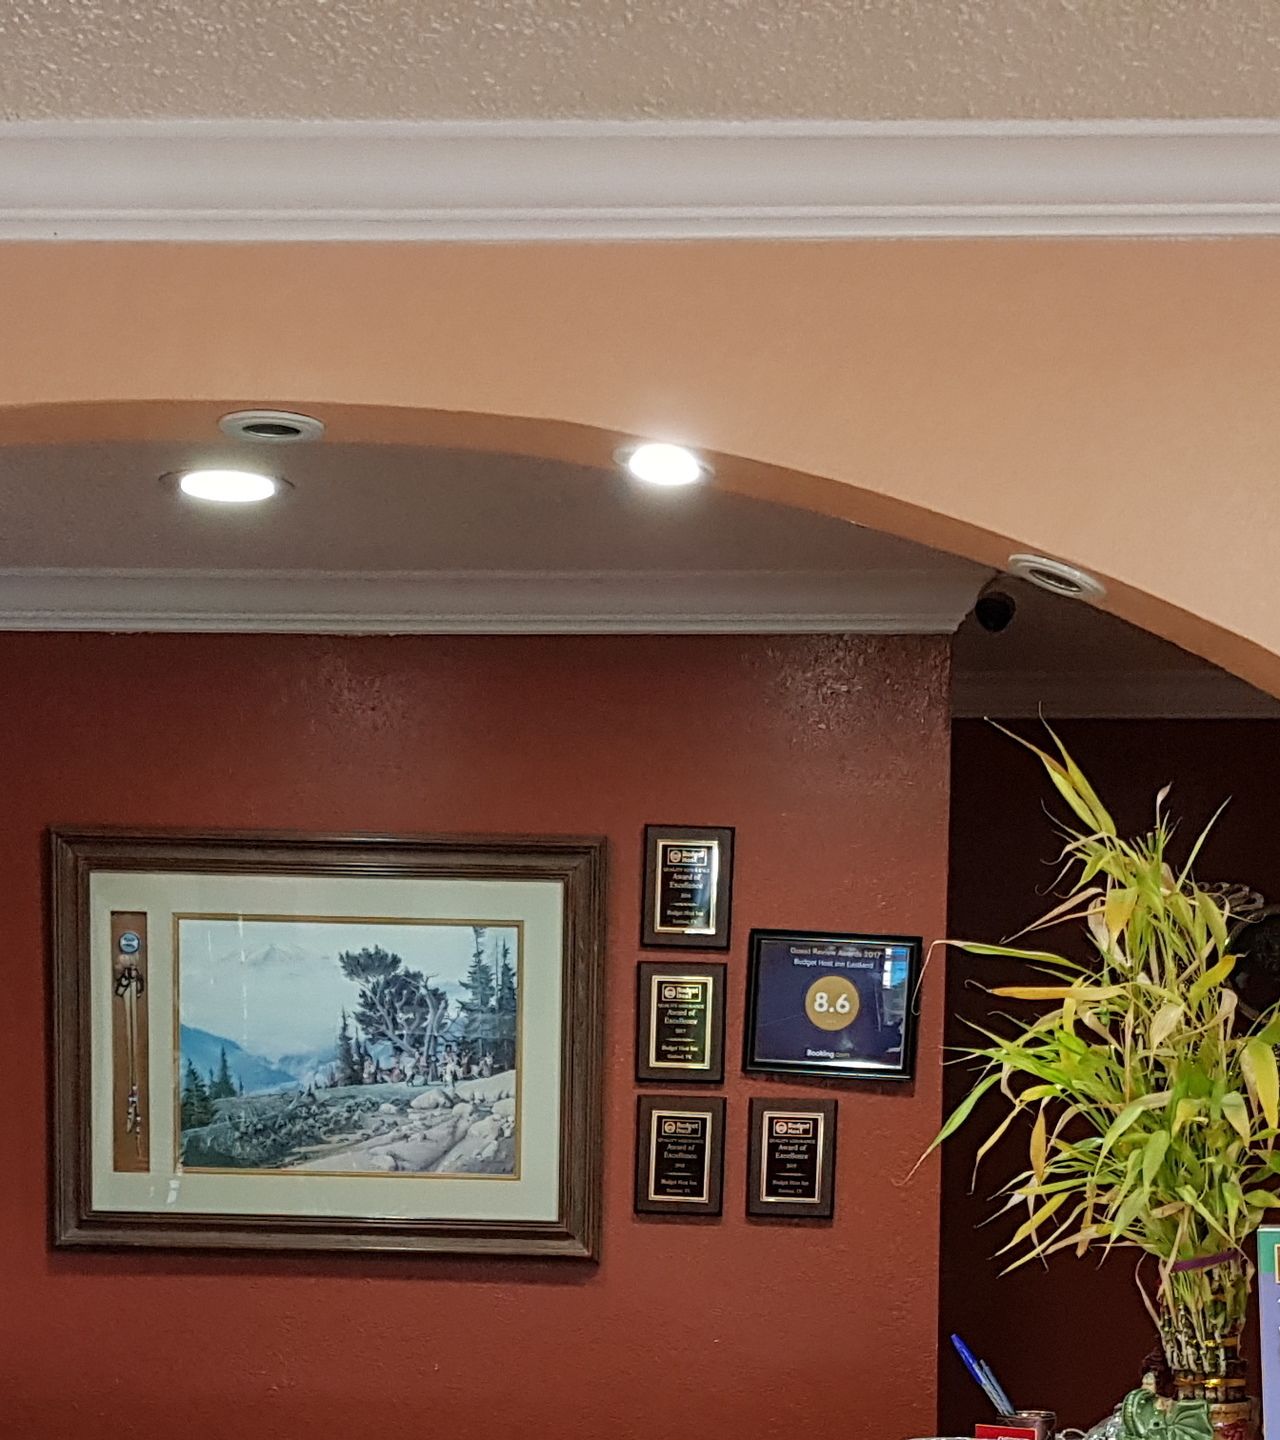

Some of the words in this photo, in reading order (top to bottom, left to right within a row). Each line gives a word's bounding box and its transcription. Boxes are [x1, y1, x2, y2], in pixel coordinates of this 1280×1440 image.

[837, 950, 863, 958] Awards
[793, 958, 817, 968] Budget
[814, 992, 851, 1014] 8.6
[666, 1143, 687, 1151] Award
